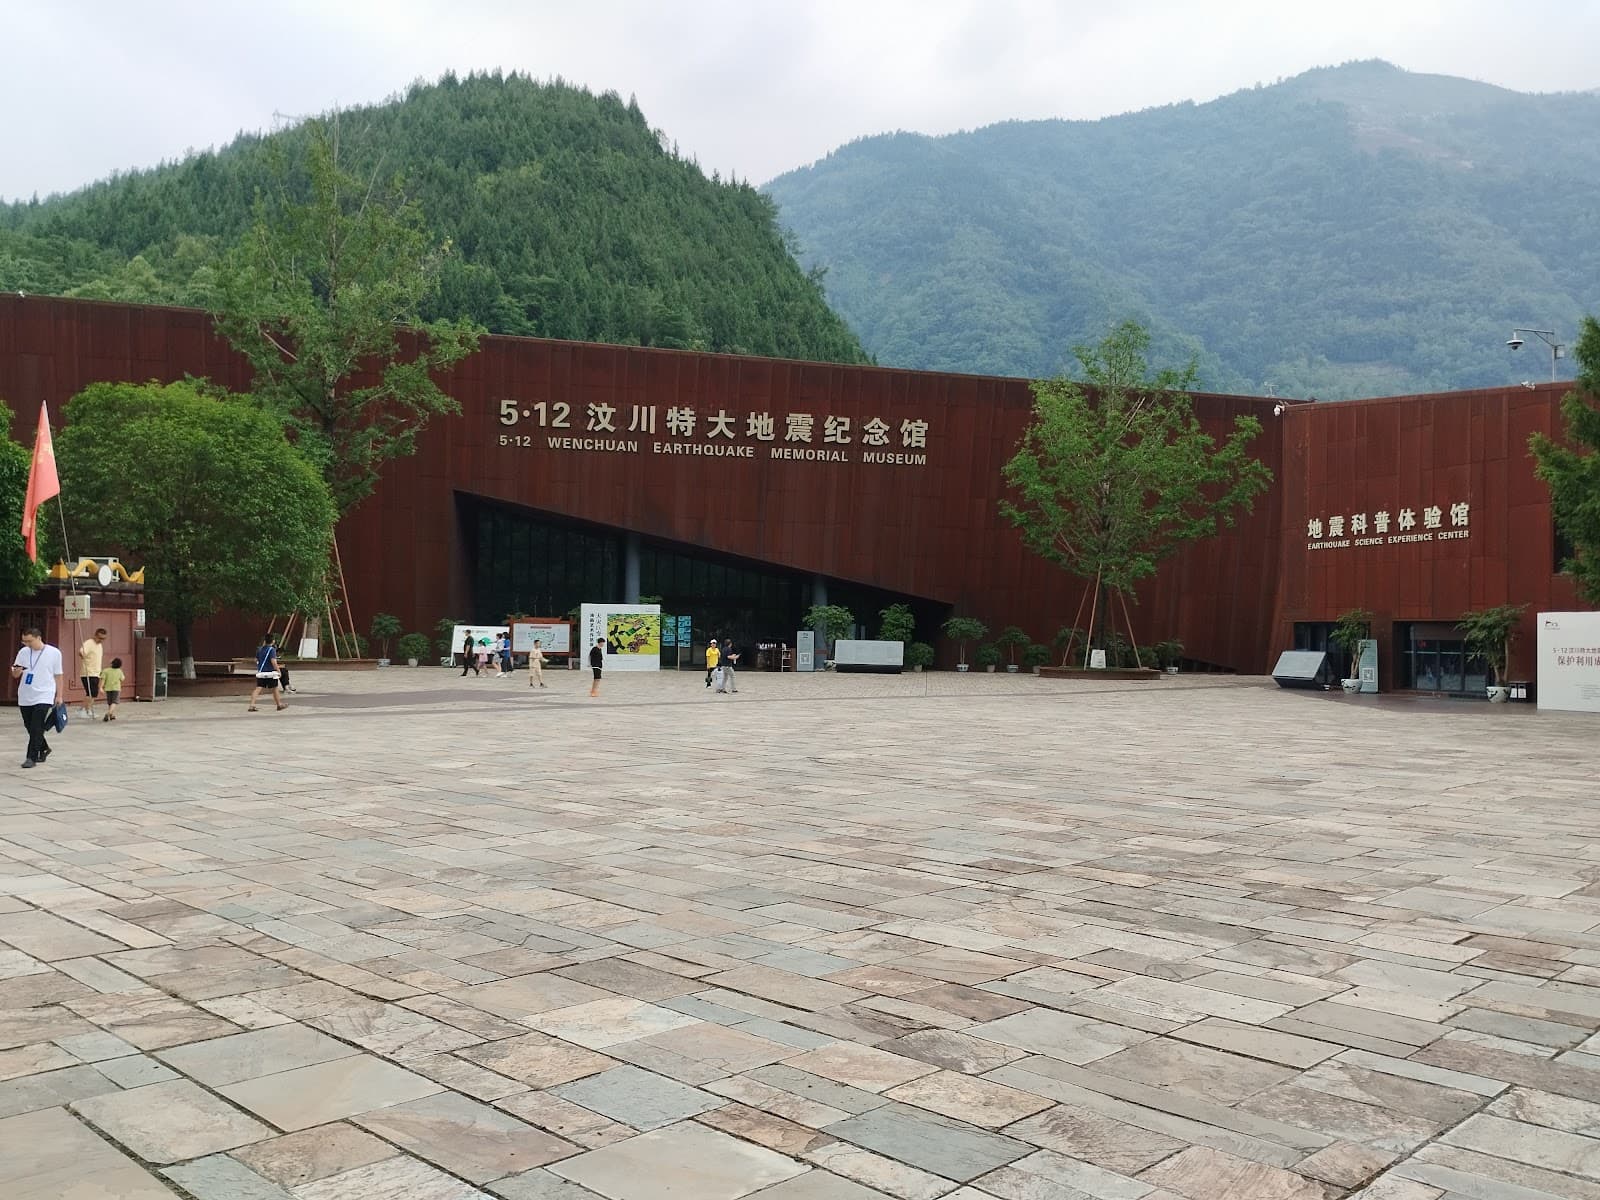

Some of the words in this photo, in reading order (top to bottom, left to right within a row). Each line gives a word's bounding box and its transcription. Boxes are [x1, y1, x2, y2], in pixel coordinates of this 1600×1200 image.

[547, 437, 638, 453] WENCHUAN
[653, 442, 754, 458] EARTHQUAKE
[771, 447, 849, 462] MEMORIAL
[863, 452, 927, 465] MUSEUM
[1307, 502, 1470, 539] 地震科普体验馆
[1307, 540, 1351, 551] EARTHQUAKE
[1354, 536, 1384, 546] SCIENCE
[1387, 533, 1433, 544] EXPERIENCE
[1438, 530, 1469, 540] CENTER
